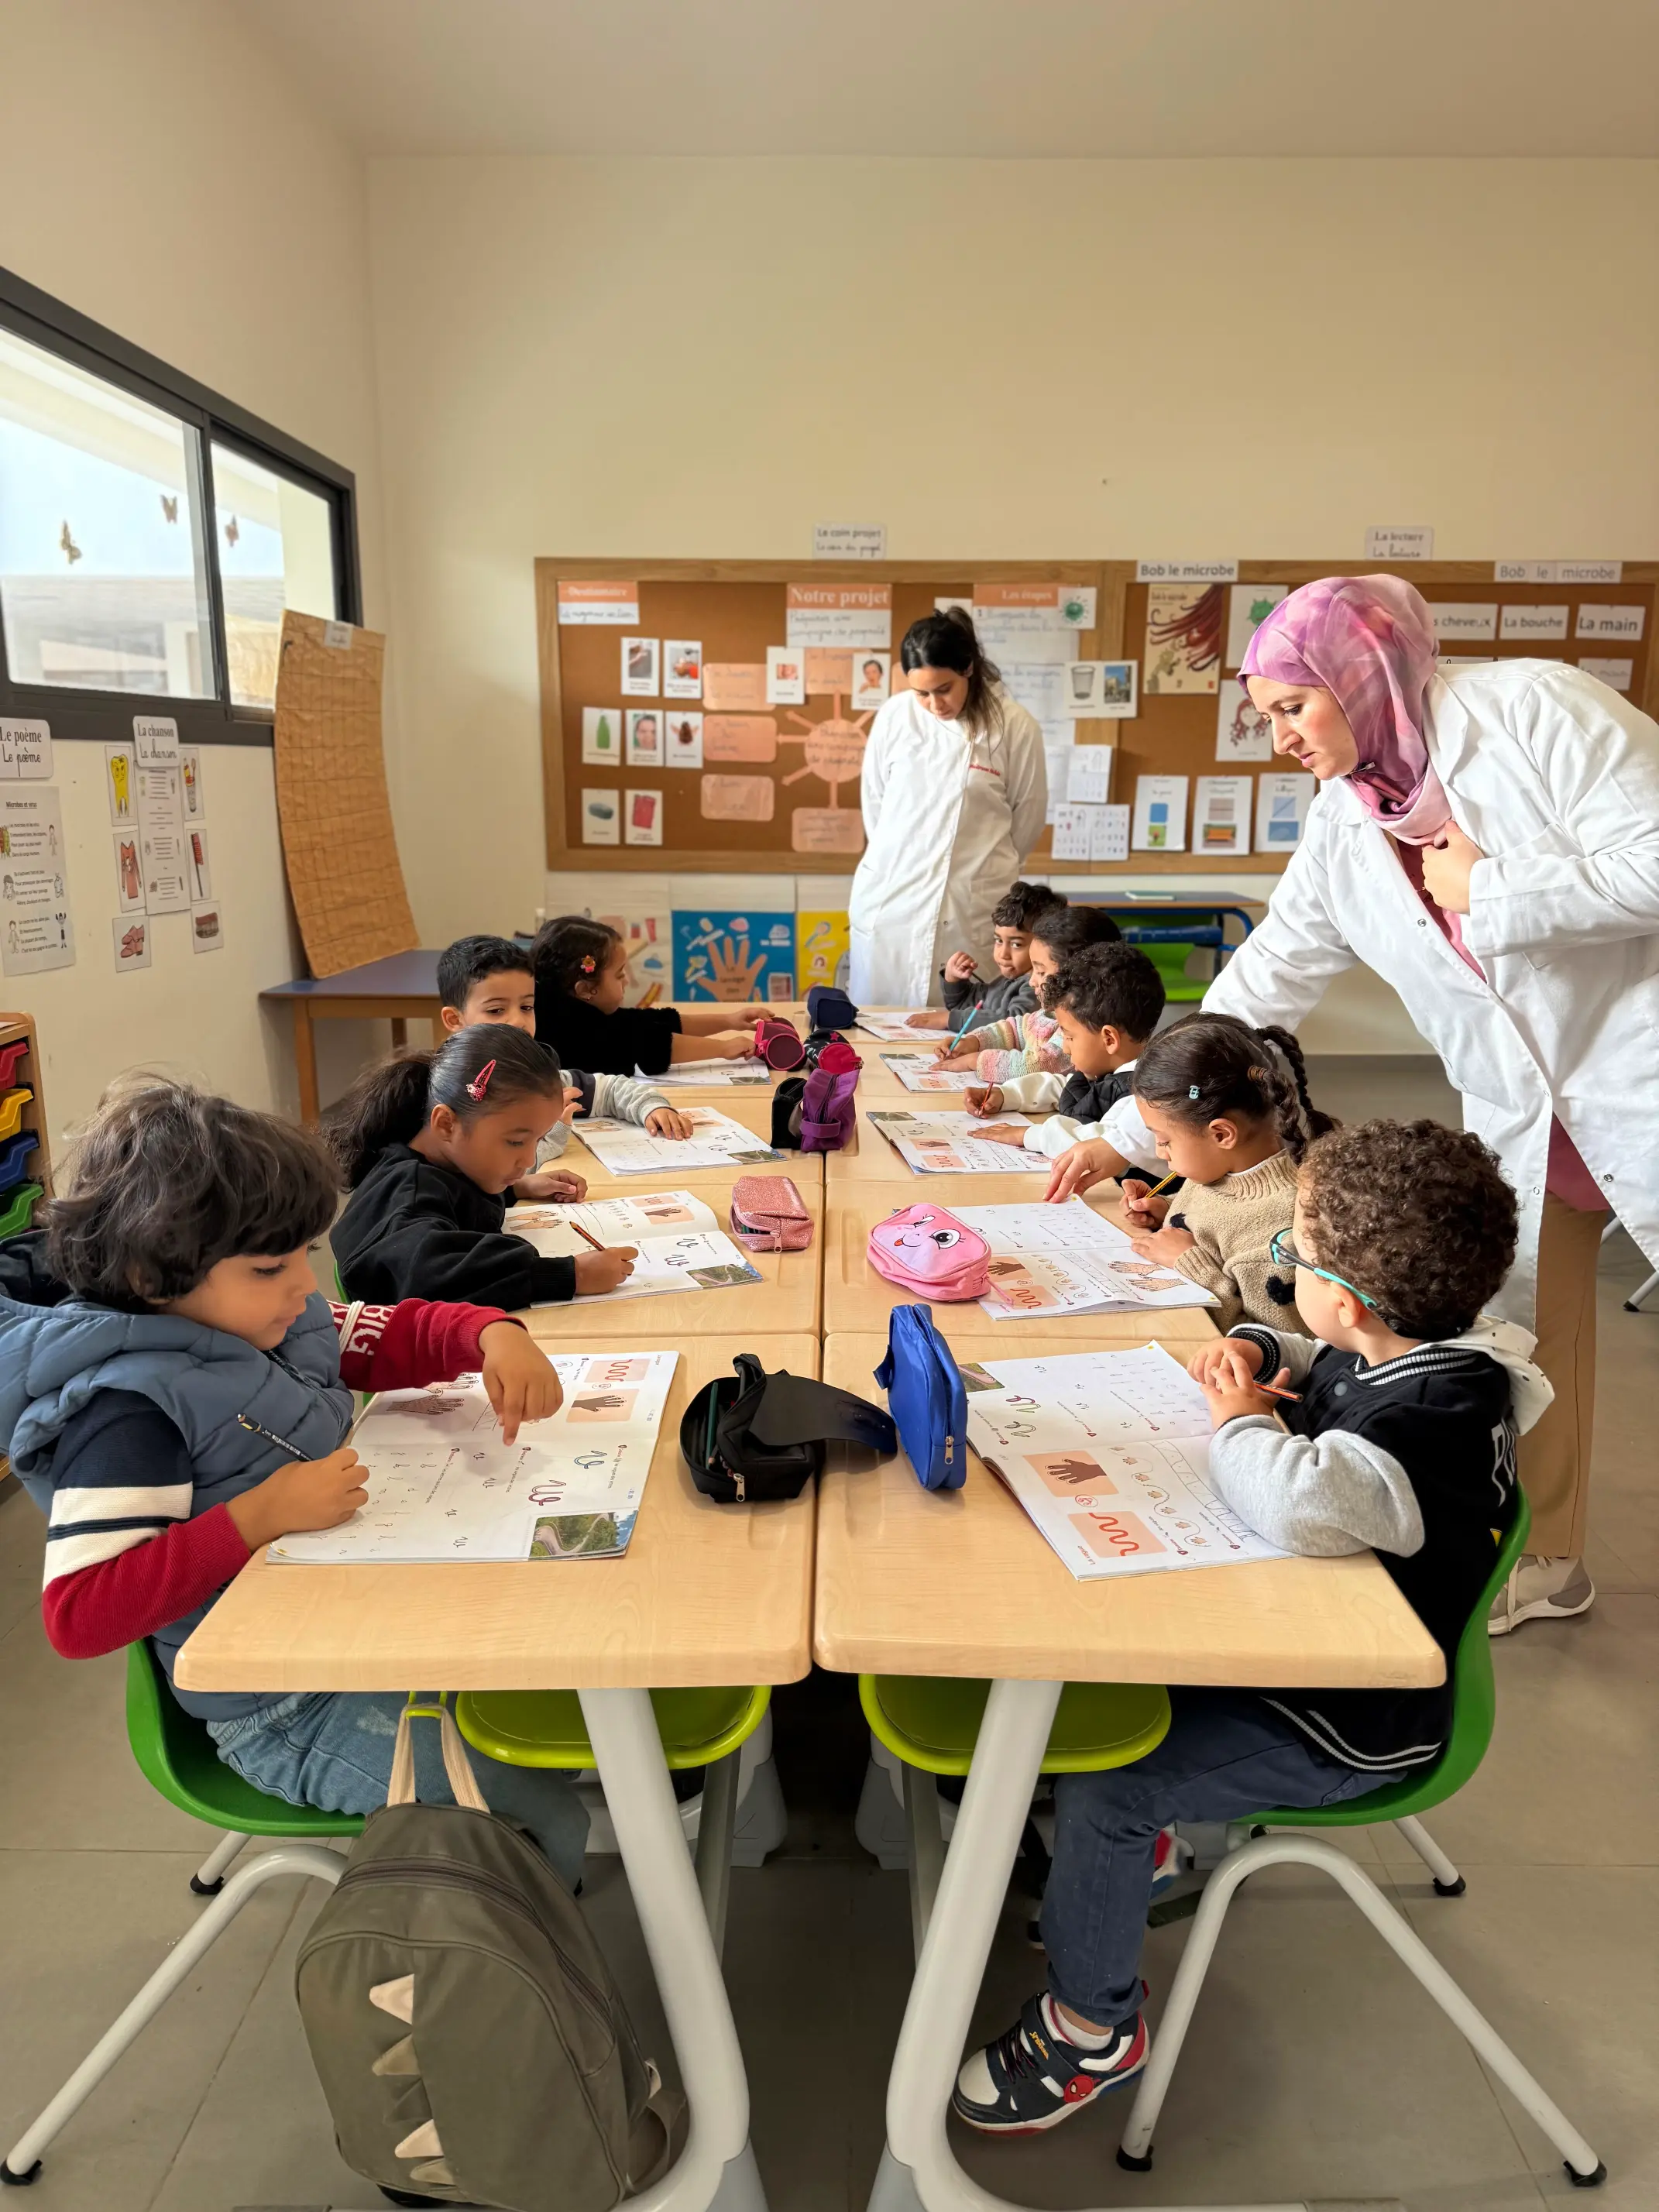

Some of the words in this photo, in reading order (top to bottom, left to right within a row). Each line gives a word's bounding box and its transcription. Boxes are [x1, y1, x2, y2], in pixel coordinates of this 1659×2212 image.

[830, 527, 850, 538] coin
[853, 528, 881, 541] projet
[1375, 531, 1387, 541] La
[1141, 565, 1166, 576] Bob
[1168, 564, 1180, 576] le
[1183, 564, 1235, 576] microbe
[1500, 565, 1526, 578] Bob
[1537, 565, 1548, 578] le
[1561, 566, 1616, 579] microbe
[792, 587, 836, 603] Notre
[840, 588, 888, 608] projet
[1002, 589, 1019, 600] Les
[1022, 589, 1053, 603] étapes
[1504, 617, 1516, 628] La
[1520, 617, 1563, 628] bouche
[1579, 617, 1595, 630] La
[1599, 618, 1638, 632] main
[0, 726, 12, 741] Le
[14, 727, 42, 746] poème
[137, 723, 146, 737] La
[148, 724, 174, 737] chanson
[139, 742, 149, 758] La
[151, 738, 177, 758] chanson
[2, 744, 13, 763] Le
[16, 747, 41, 777] poème
[1077, 1543, 1091, 1561] vague
